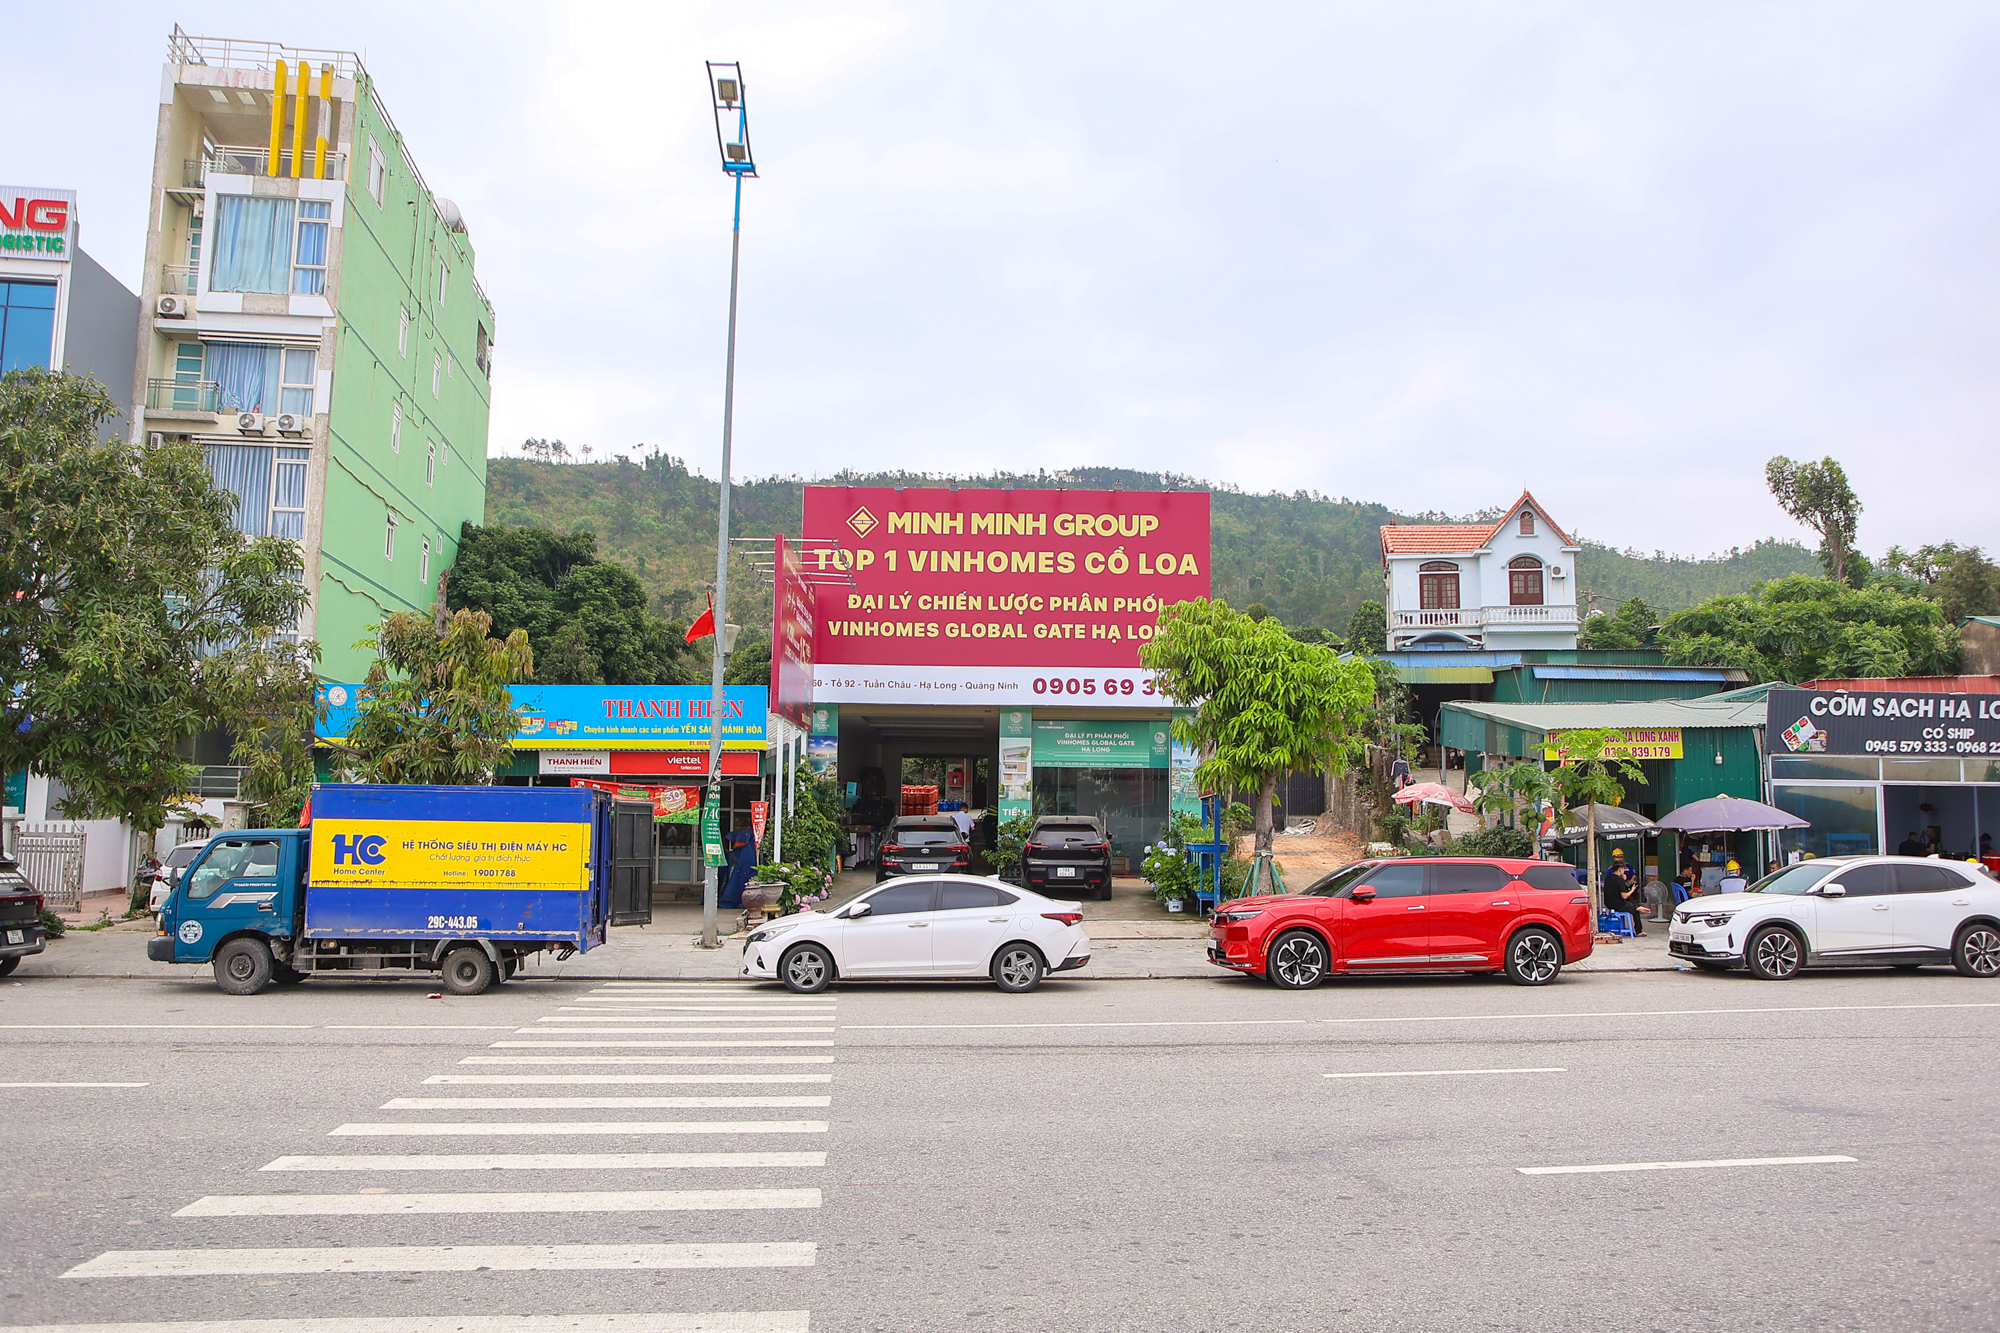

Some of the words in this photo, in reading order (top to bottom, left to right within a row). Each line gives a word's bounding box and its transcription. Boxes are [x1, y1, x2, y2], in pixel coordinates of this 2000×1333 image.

[888, 512, 964, 534] MINH
[970, 512, 1046, 535] MINH
[1053, 513, 1159, 536] GROUP
[814, 549, 875, 571] TOP
[884, 550, 897, 572] 1
[908, 550, 1076, 573] VINHOMES
[1084, 546, 1129, 574] CỔ
[1138, 553, 1199, 575] LOA
[848, 594, 883, 613] ĐẠI
[889, 591, 912, 610] LÝ
[918, 591, 982, 610] CHIẾN
[988, 593, 1043, 615] LƯỢC
[1049, 592, 1107, 612] PHÂN
[828, 621, 939, 638] VINHOMES
[945, 622, 1027, 639] GLOBAL
[1033, 624, 1086, 639] GATE
[1092, 624, 1122, 643] HẠ
[831, 678, 842, 687] Tổ
[864, 679, 885, 689] Tuần
[888, 680, 911, 689] Châu
[919, 682, 931, 691] Hạ
[934, 682, 956, 691] Long
[965, 681, 995, 691] Quảng
[1032, 678, 1096, 695] 0905
[1104, 679, 1134, 695] 69
[602, 700, 682, 718] THANH
[1810, 694, 1866, 717] CƠM
[1872, 698, 1934, 721] SẠCH
[1940, 700, 1972, 722] HẠ
[584, 725, 605, 734] Chuyên
[639, 725, 650, 733] các
[651, 726, 662, 734] sản
[663, 724, 679, 735] phẩm
[681, 723, 696, 734] YẾN
[722, 723, 744, 734] HÁNH
[746, 724, 762, 734] HÒA
[1922, 723, 1944, 739] CÓ
[1947, 728, 1974, 740] SHIP
[1635, 732, 1656, 742] LONG
[1657, 732, 1679, 742] XANH
[1865, 740, 1896, 753] 0945
[1899, 740, 1922, 753] 579
[1923, 740, 1947, 753] 333
[1956, 741, 1987, 753] 0968
[667, 756, 702, 764] viettel
[664, 790, 681, 802] 30
[1564, 825, 1588, 835] 78wi
[402, 839, 414, 852] HỆ
[418, 838, 454, 851] THỐNG
[457, 840, 478, 851] SIÊU
[481, 842, 496, 852] THỊ
[500, 841, 522, 852] ĐIỆN
[526, 840, 549, 852] MÁY
[552, 843, 568, 852] HC
[430, 852, 448, 861] Chất
[448, 853, 470, 863] lượng
[474, 854, 487, 863] giá
[514, 854, 531, 863] thực
[428, 916, 478, 929] 29C-443.05
